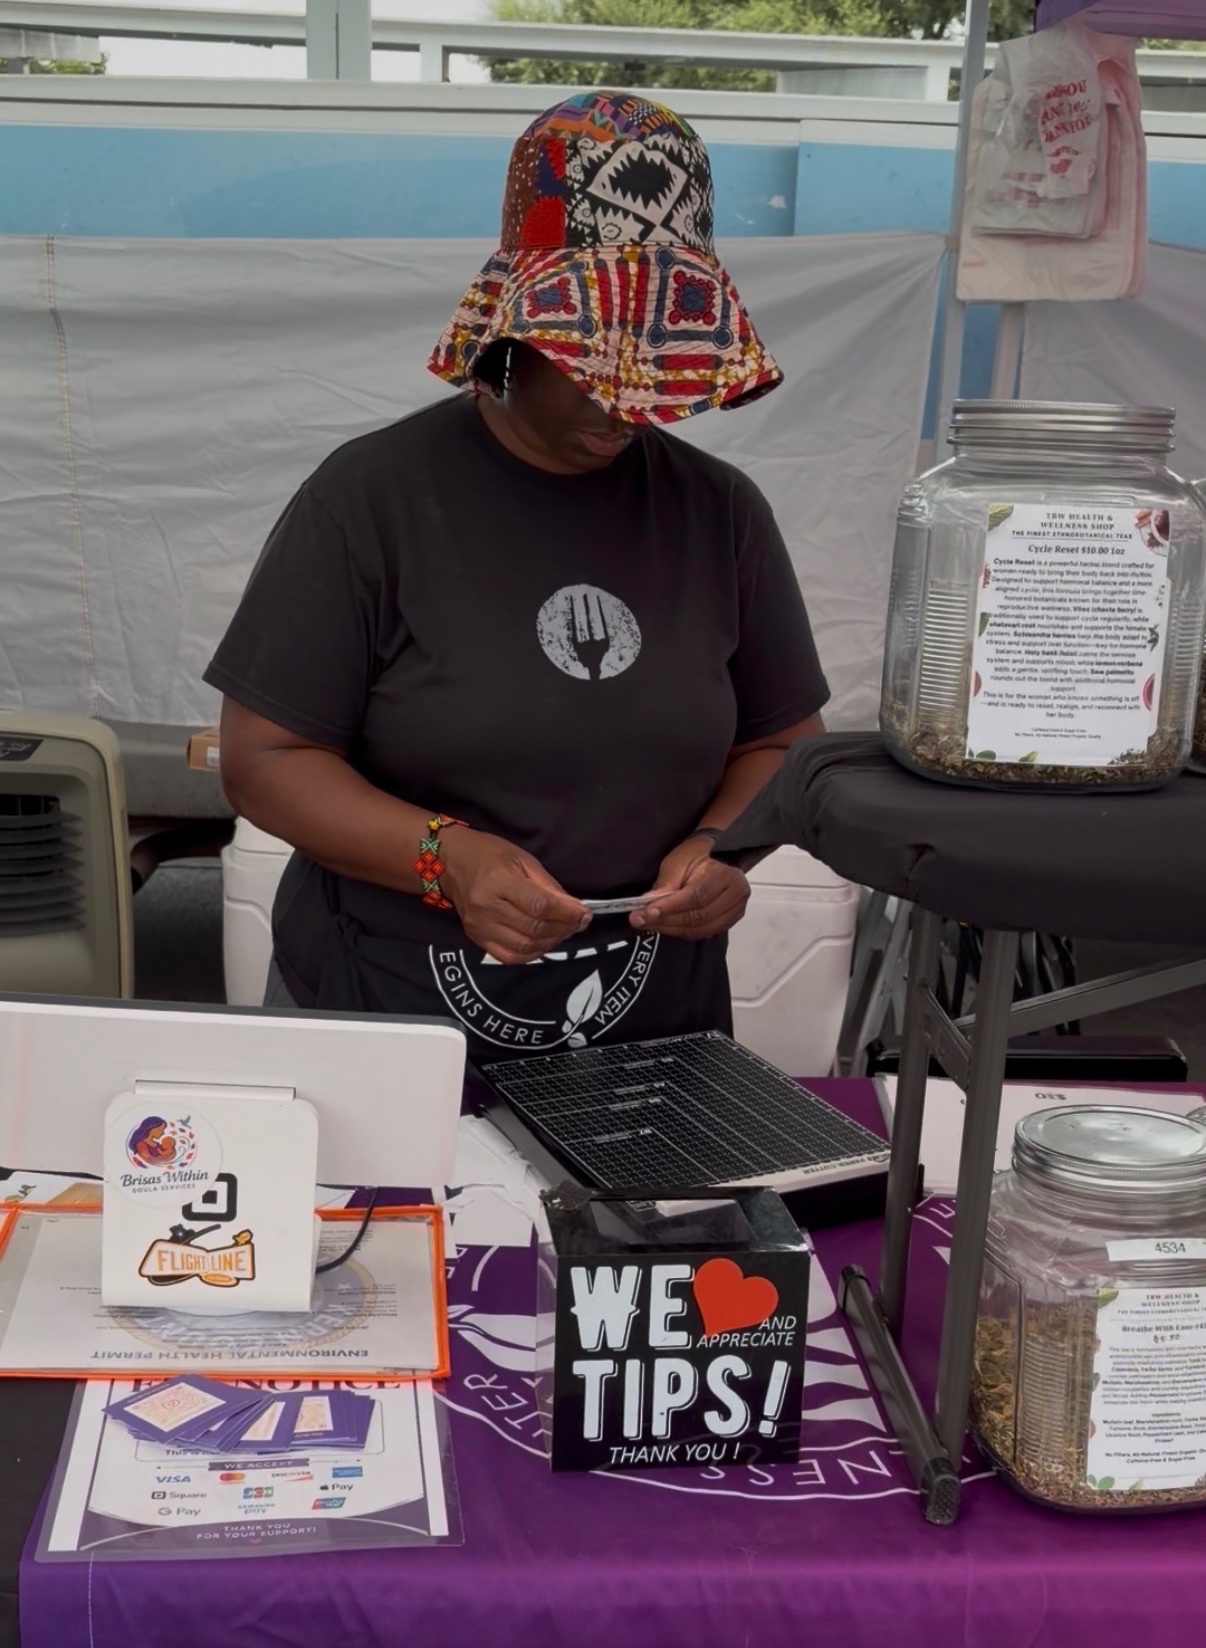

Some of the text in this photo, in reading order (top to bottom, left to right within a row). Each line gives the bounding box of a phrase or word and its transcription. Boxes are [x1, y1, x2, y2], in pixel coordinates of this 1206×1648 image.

[1040, 521, 1088, 529] WELLNESS
[1052, 531, 1112, 539] ETHNOBOTANICAL
[1027, 543, 1125, 556] Cycle Reset $10.00 1oz
[993, 557, 1013, 565] Cycle
[1014, 558, 1034, 566] Reset
[594, 986, 631, 1026] ITEM
[483, 1015, 544, 1045] HERE
[120, 1169, 209, 1188] Brisas Within
[132, 1183, 196, 1194] DOULA SERVICES
[1154, 1241, 1186, 1254] 4534
[570, 1264, 695, 1351] WE
[758, 1315, 798, 1331] AND
[696, 1331, 796, 1349] APPRECIATE
[89, 1349, 369, 1360] ENVIRONMENTAL HEALTH PERMIT
[572, 1354, 792, 1442] TIPS!
[609, 1446, 680, 1465] THANK
[684, 1443, 727, 1461] YOU
[224, 1460, 294, 1470] WE ACCEPT
[156, 1475, 192, 1484] VISA
[331, 1483, 354, 1492] Pay
[169, 1491, 207, 1500] Square
[176, 1506, 202, 1517] Pay
[224, 1531, 255, 1539] YOUR
[259, 1527, 317, 1537] SUPPORT!
